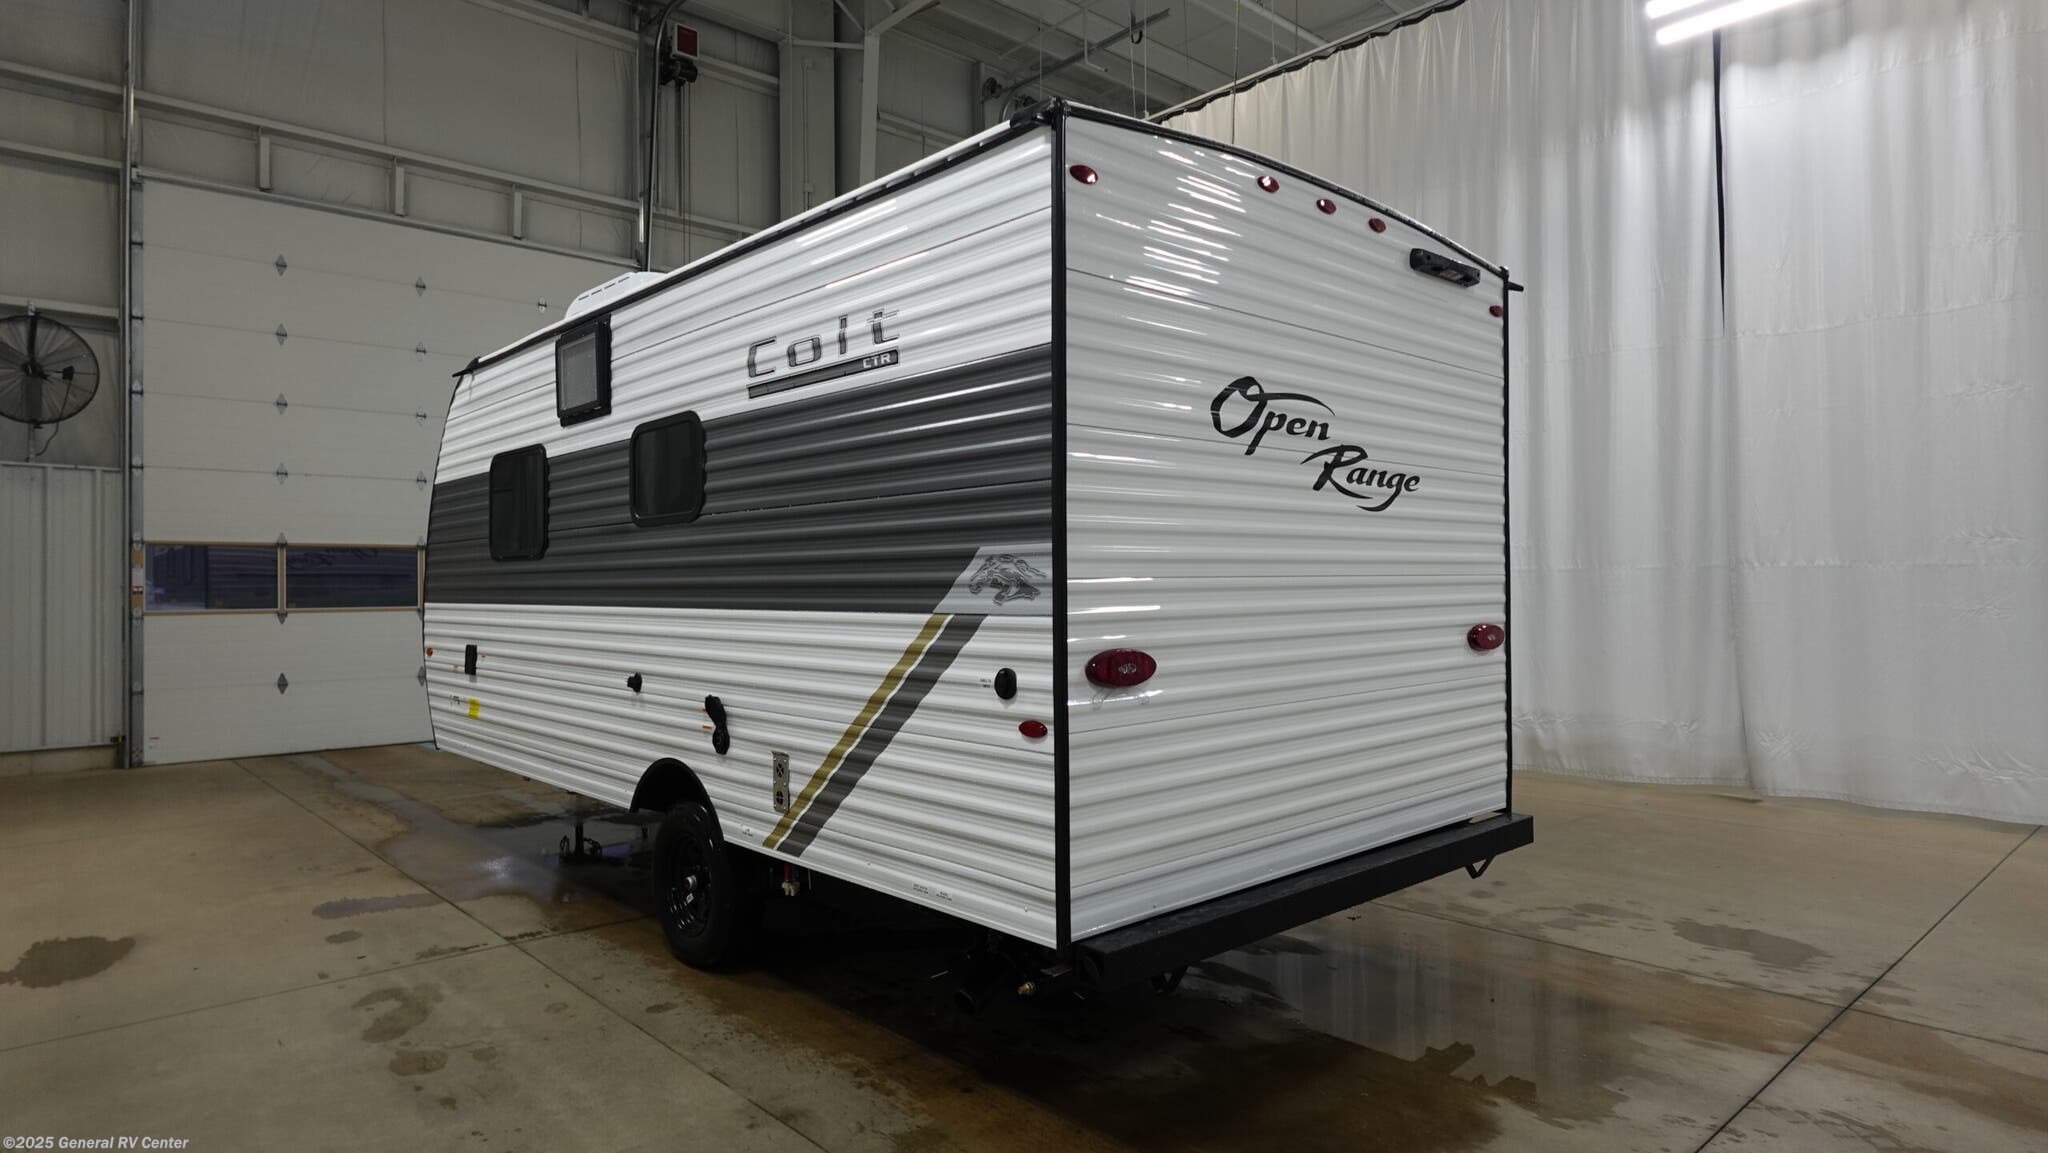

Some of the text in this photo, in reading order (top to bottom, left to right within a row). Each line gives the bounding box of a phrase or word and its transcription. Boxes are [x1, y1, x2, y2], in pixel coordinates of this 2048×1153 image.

[748, 309, 900, 378] Colt
[862, 352, 891, 369] CTR
[1210, 376, 1336, 456] Open
[1300, 444, 1421, 512] Range
